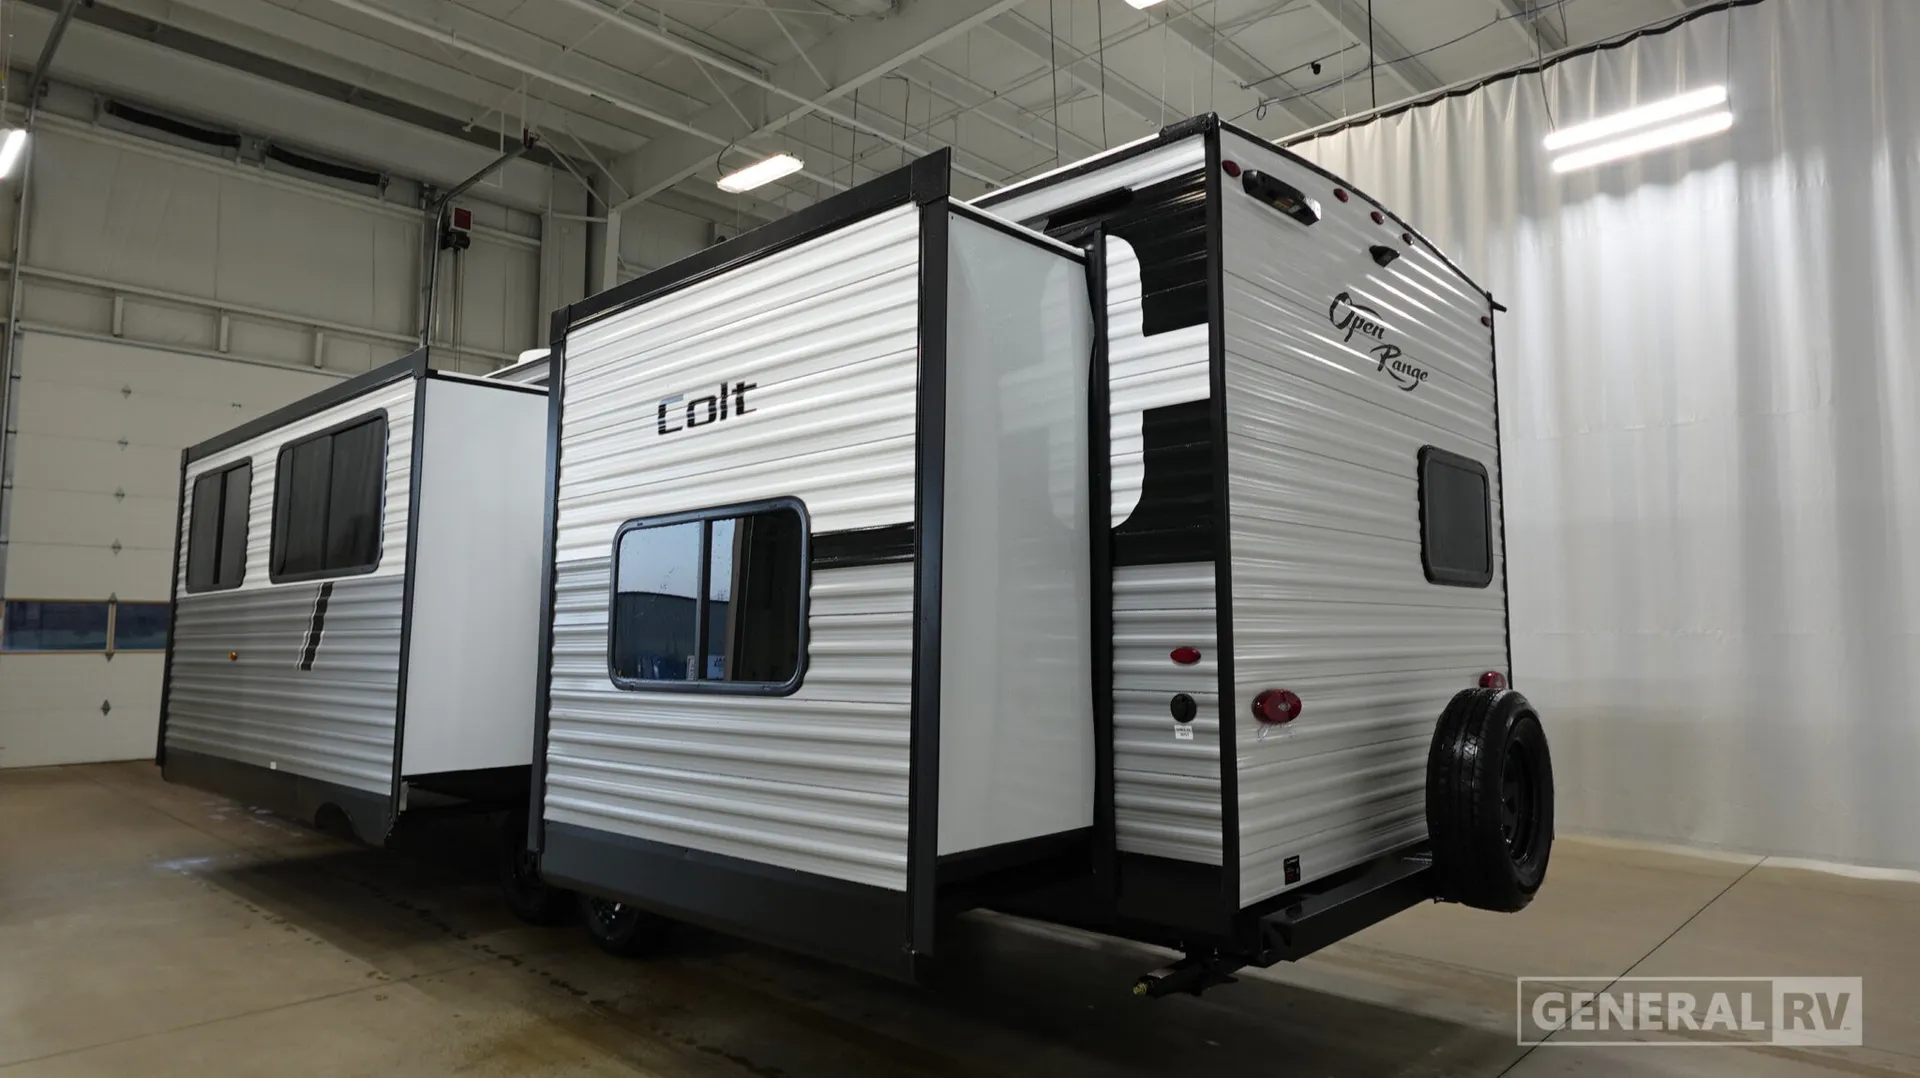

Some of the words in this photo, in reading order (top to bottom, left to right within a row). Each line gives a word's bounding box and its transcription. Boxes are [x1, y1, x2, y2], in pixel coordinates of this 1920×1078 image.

[1329, 292, 1385, 342] Open
[1370, 344, 1428, 391] Range
[658, 382, 757, 435] Colt
